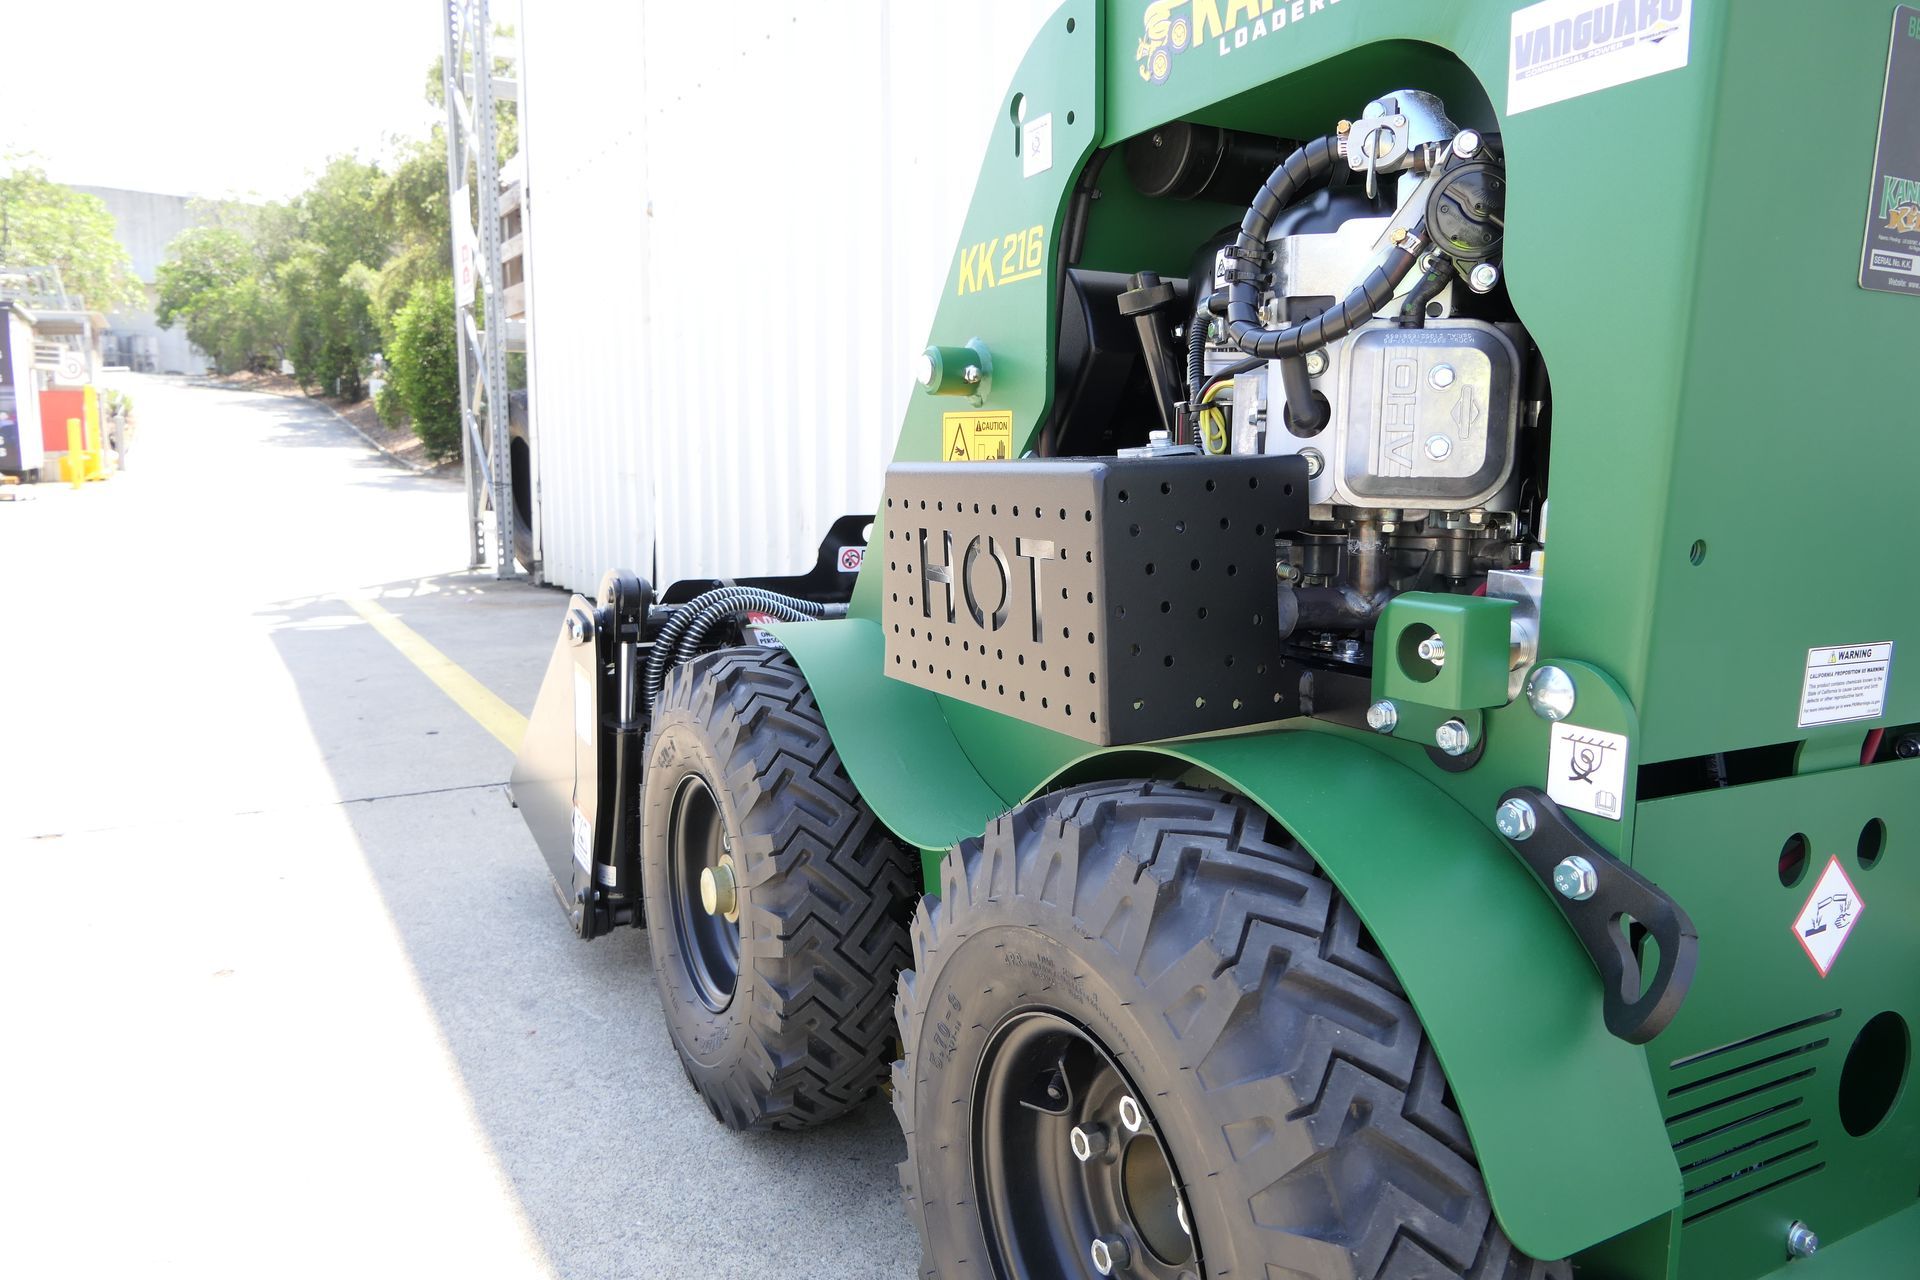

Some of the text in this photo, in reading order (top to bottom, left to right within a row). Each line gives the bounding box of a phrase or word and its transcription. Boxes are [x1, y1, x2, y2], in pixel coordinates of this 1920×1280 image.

[1219, 0, 1342, 56] LOADER
[1525, 41, 1624, 78] COMMERCIAL POWER
[957, 224, 1044, 297] KK 216
[1874, 255, 1892, 266] SERIAL
[982, 420, 1008, 431] CAUTION
[1384, 357, 1418, 470] OHV
[919, 527, 1055, 644] HOT
[1838, 648, 1872, 661] WARNING
[1809, 672, 1833, 680] CALIFORNIA
[1835, 668, 1861, 676] PROPOSITION
